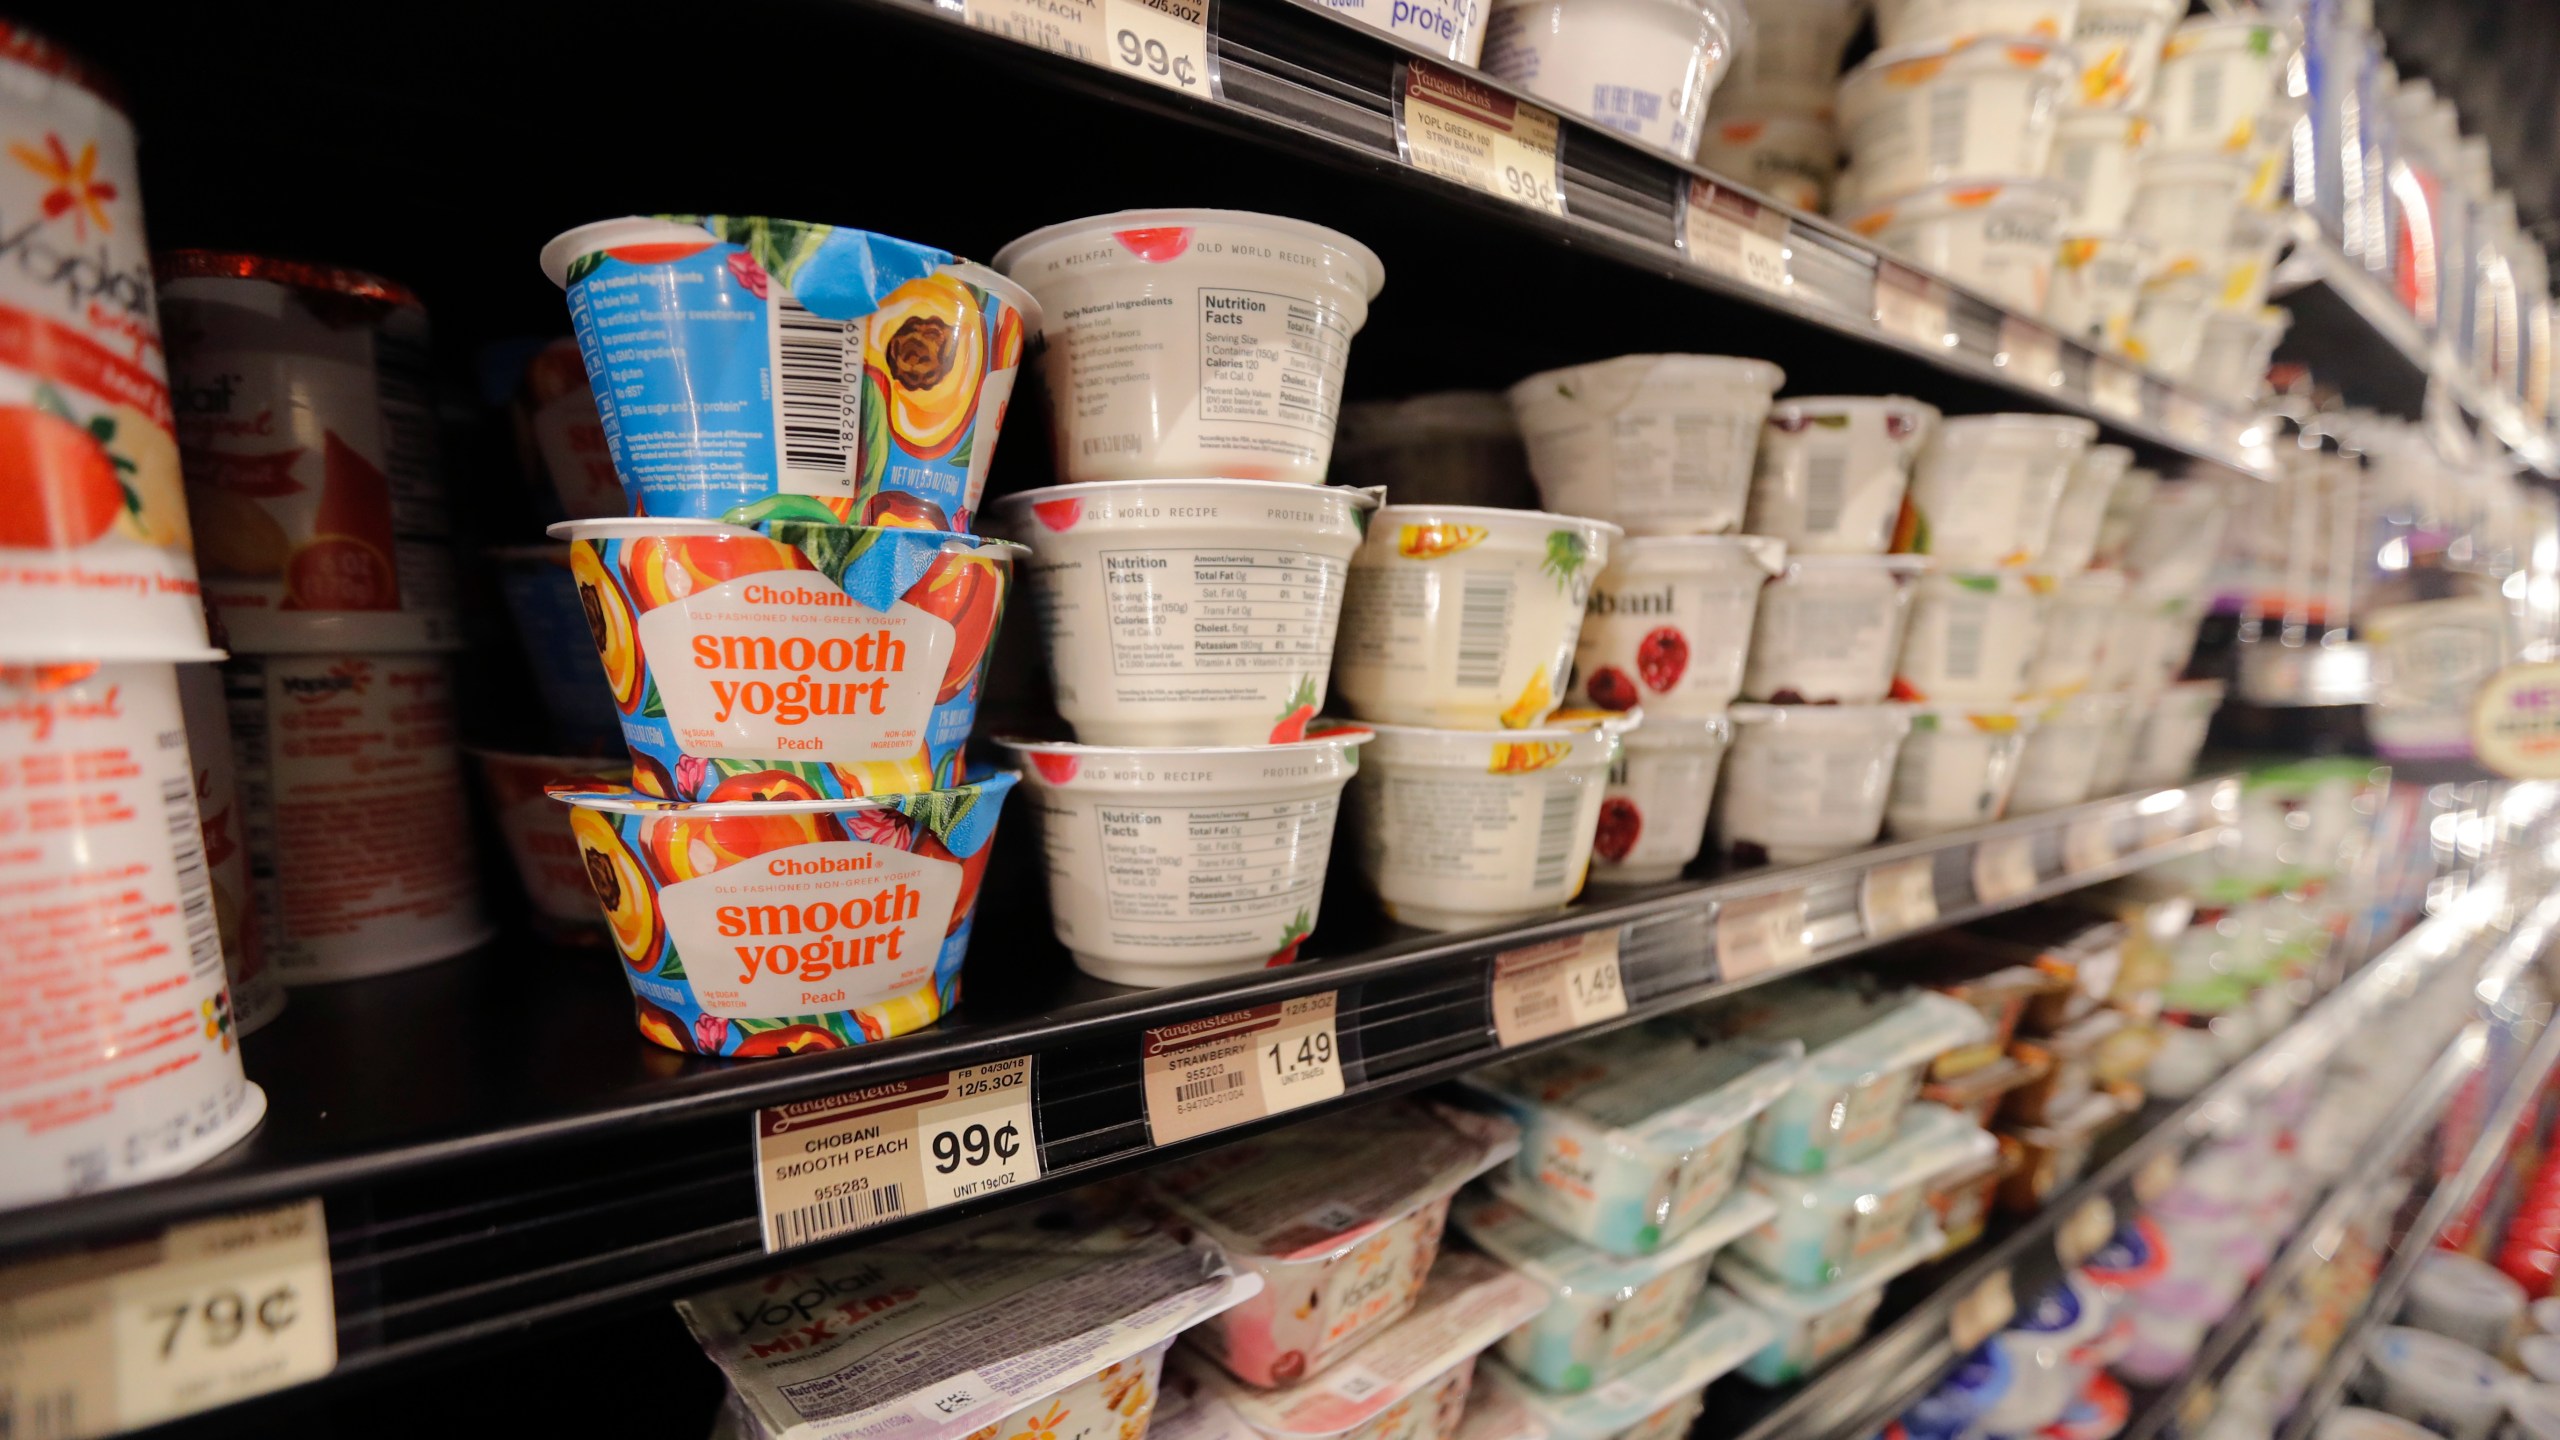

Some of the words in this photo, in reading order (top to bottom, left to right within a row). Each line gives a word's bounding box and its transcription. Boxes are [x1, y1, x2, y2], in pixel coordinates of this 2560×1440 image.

[1117, 28, 1196, 87] 99¢
[1417, 111, 1442, 130] YOPL
[1444, 121, 1475, 142] GREEK
[1505, 163, 1554, 208] 99¢
[1066, 248, 1114, 266] MILKFAT
[1197, 243, 1223, 253] OLD
[1231, 244, 1272, 258] WORLD
[1279, 251, 1317, 267] RECIPE
[1063, 310, 1080, 320] Only
[1081, 301, 1114, 314] Natural
[1116, 297, 1173, 310] Ingredients
[1205, 295, 1266, 312] Nutrition
[1206, 311, 1243, 325] Facts
[1206, 333, 1239, 345] Serving
[1241, 335, 1258, 345] Size
[844, 323, 859, 383] 01169
[1212, 345, 1254, 357] Container
[1256, 348, 1279, 361] (150g)
[1206, 358, 1243, 369] Calories
[1245, 360, 1259, 370] 120
[1214, 371, 1228, 380] Fat
[1230, 371, 1246, 381] Cal.
[1247, 373, 1254, 381] 0
[842, 394, 856, 451] 18290
[841, 478, 851, 486] 8
[891, 466, 908, 486] NET
[1119, 508, 1160, 519] WORLD
[1169, 507, 1219, 518] RECIPE
[1267, 508, 1315, 522] PROTEIN
[1106, 557, 1167, 570] Nutrition
[1194, 555, 1254, 564] Amount/serving
[1194, 571, 1218, 580] Total
[1219, 571, 1234, 580] Fat
[1236, 572, 1247, 581] 0g
[1202, 588, 1219, 598] Sat.
[1221, 589, 1235, 598] Fat
[1236, 589, 1247, 599] 0g
[1161, 603, 1188, 614] (150g)
[1203, 606, 1224, 615] Trans
[1226, 606, 1241, 615] Fat
[690, 612, 788, 623] OLD-FASHIONED
[791, 615, 861, 625] NON-GREEK
[866, 617, 907, 625] YOGURT
[1114, 616, 1149, 625] Calories
[1194, 623, 1230, 633] Cholest.
[692, 630, 906, 672] smooth
[1194, 640, 1238, 650] Potassium
[710, 675, 889, 725] yogurt
[694, 729, 715, 737] SUGAR
[884, 730, 916, 738] NON-GMO
[695, 740, 723, 748] PROTEIN
[776, 736, 824, 750] Peach
[871, 740, 913, 749] INGREDIENTS
[1083, 769, 1106, 780] OLD
[1114, 771, 1155, 781] WORLD
[1164, 772, 1213, 781] RECIPE
[1263, 767, 1309, 778] PROTEIN
[1102, 811, 1162, 825] Nutrition
[1104, 825, 1139, 837] Facts
[1189, 827, 1211, 836] Total
[1214, 826, 1228, 835] Fat
[767, 852, 873, 877] Chobani
[1109, 865, 1144, 875] Calories
[815, 876, 881, 889] NON-GREEK
[884, 870, 922, 881] YOGURT
[1189, 891, 1232, 901] Potassium
[715, 883, 921, 937] smooth
[734, 925, 906, 984] yogurt
[718, 1000, 747, 1008] PROTEIN
[800, 989, 846, 1005] Peach
[1285, 996, 1333, 1016] 12/5.3OZ
[1169, 1044, 1246, 1071] STRAWBERRY
[1269, 1032, 1331, 1075] 1.49
[958, 1070, 972, 1079] FB
[980, 1059, 1024, 1075] 04/30/18
[1186, 1064, 1225, 1082] 955203
[957, 1072, 1023, 1097] 12/5.3OZ
[1281, 1074, 1300, 1086] UNIT
[1177, 1090, 1244, 1114] 8-94700-01004
[805, 1126, 880, 1153] CHOBANI
[932, 1120, 1020, 1175] 99¢
[777, 1151, 849, 1180] SMOOTH
[854, 1138, 908, 1164] PEACH
[814, 1177, 869, 1201] 955283
[953, 1182, 978, 1199] UNIT
[981, 1172, 1016, 1192] 19¢/OZ
[146, 1284, 298, 1365] 79¢
[785, 1379, 835, 1398] Nutrition
[834, 1363, 867, 1383] Facts
